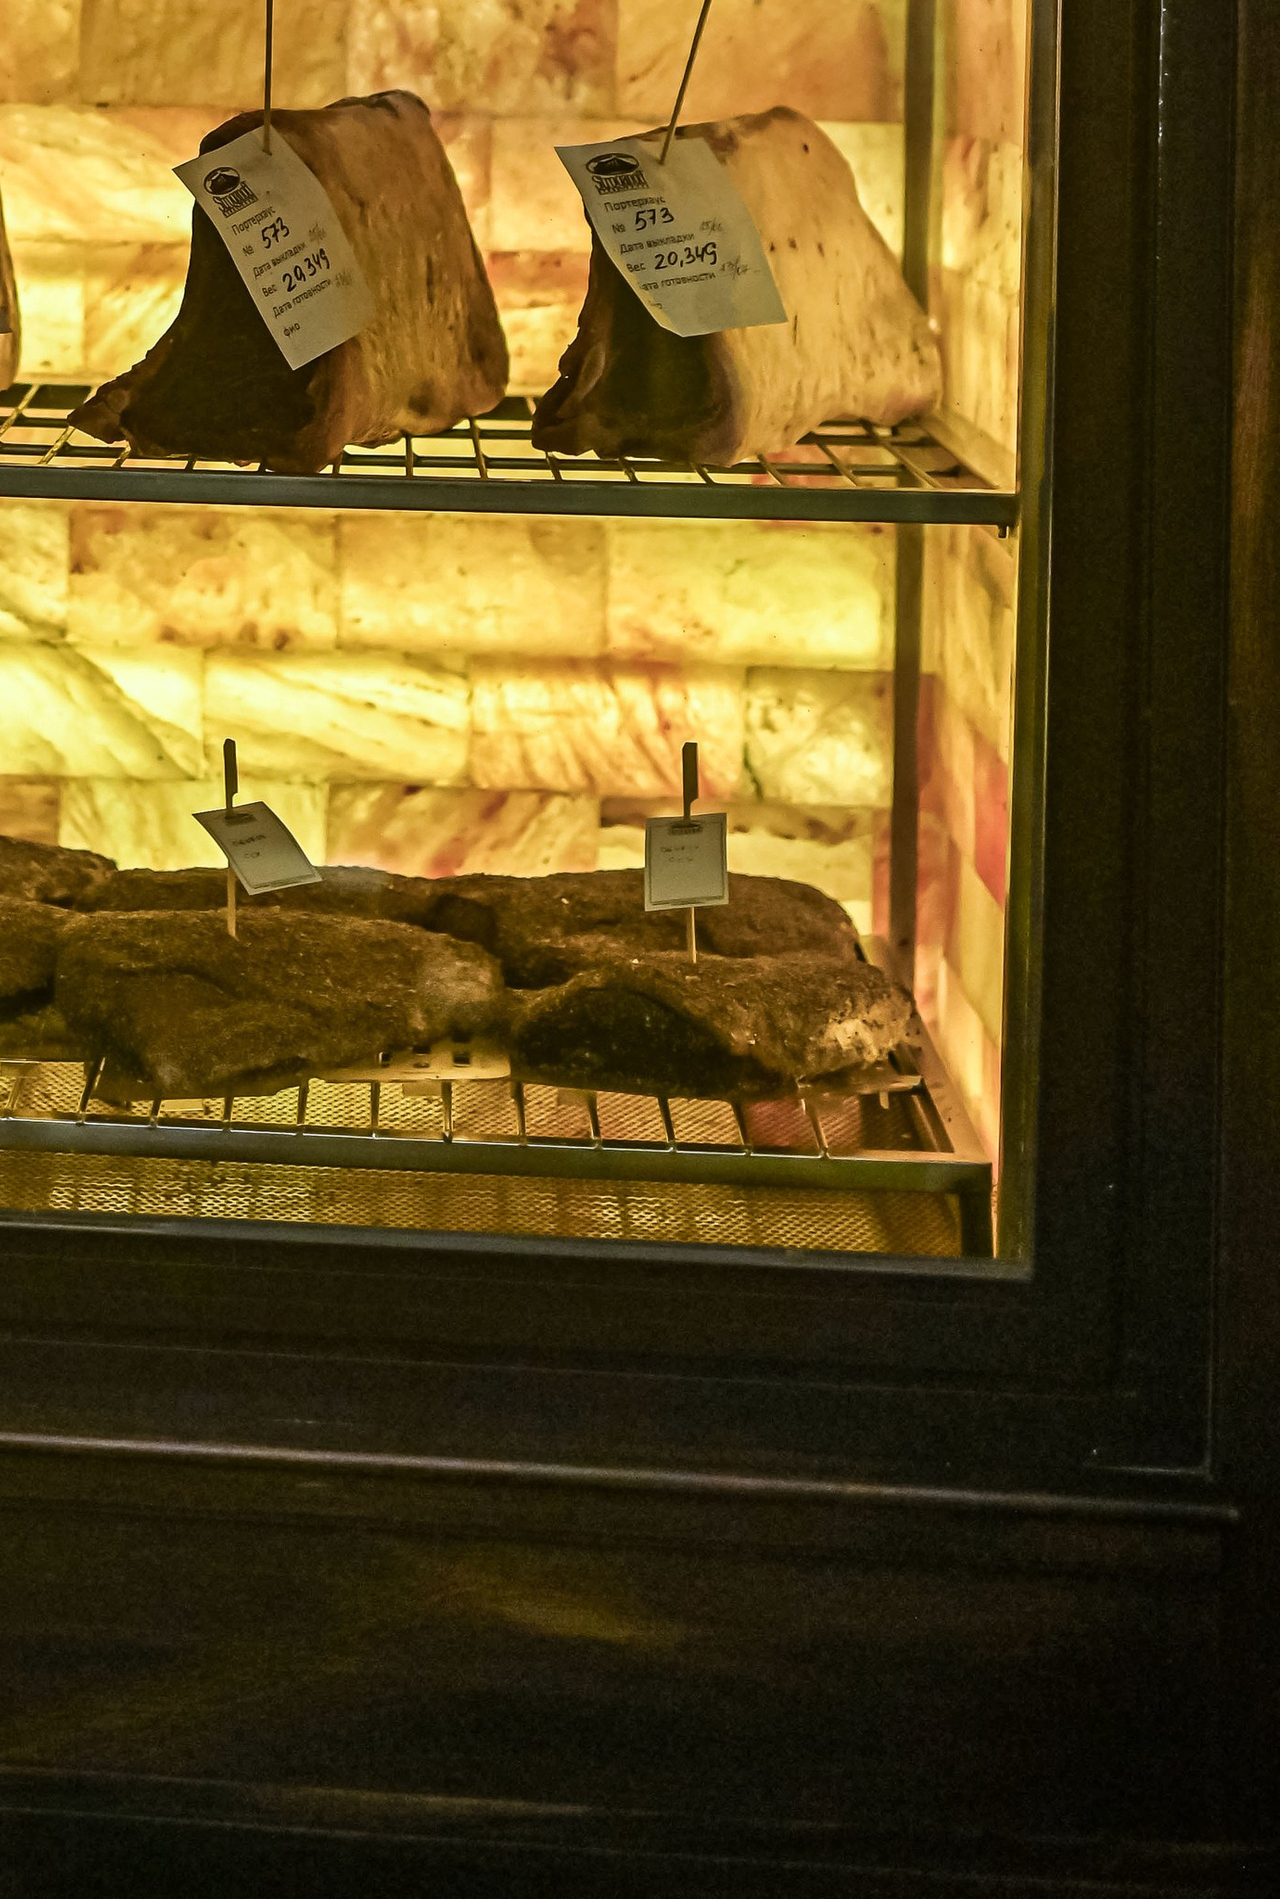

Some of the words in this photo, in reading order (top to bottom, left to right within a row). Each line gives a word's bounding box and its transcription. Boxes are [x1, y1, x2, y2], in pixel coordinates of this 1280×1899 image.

[604, 196, 666, 213] Портерхаус
[231, 205, 277, 236] Портерхаус
[635, 207, 674, 232] 573
[261, 217, 290, 249] 573
[620, 241, 644, 254] Дата
[647, 233, 695, 249] выкладки
[253, 261, 272, 280] Дата
[271, 241, 308, 267] выкладки
[626, 262, 646, 273] Вес
[654, 242, 718, 271] 20,349
[261, 284, 278, 298] Вес
[639, 281, 659, 291] ата
[660, 272, 716, 288] готовности
[272, 301, 293, 318] Дата
[292, 278, 332, 307] готовности
[283, 322, 301, 338] фио
